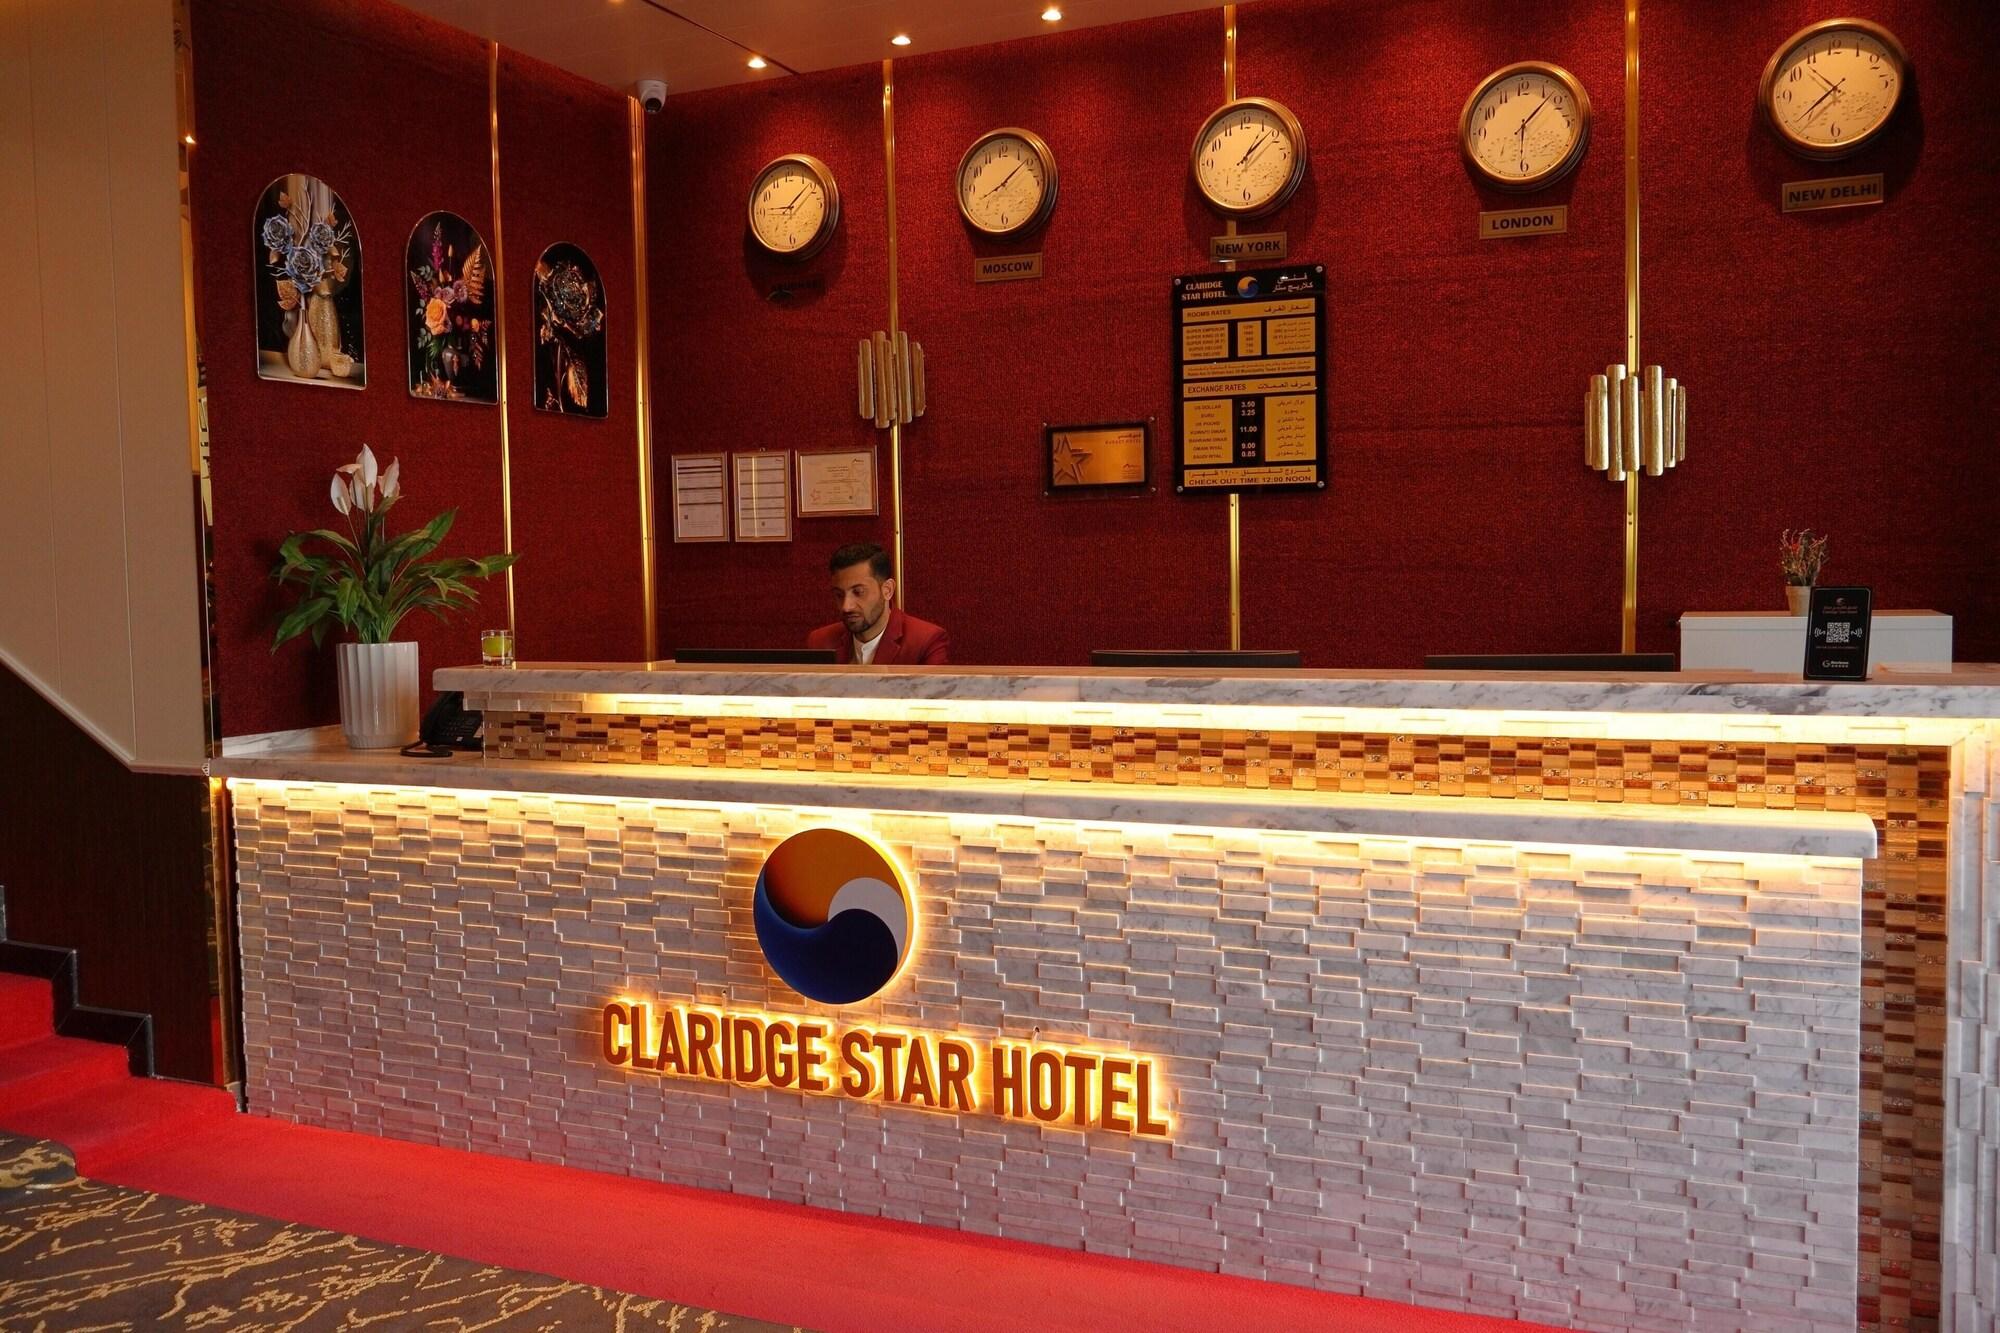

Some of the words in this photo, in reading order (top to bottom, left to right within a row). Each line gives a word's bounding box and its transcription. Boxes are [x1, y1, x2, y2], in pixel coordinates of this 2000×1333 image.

[1827, 39, 1843, 56] 12
[1806, 49, 1817, 65] 11
[1869, 53, 1882, 70] 2
[1790, 65, 1803, 83] 10
[1517, 80, 1530, 97] 12
[1782, 89, 1794, 103] 9
[1499, 89, 1508, 105] 11
[1553, 95, 1563, 111] 2
[1484, 105, 1496, 121] 10
[1224, 122, 1232, 137] 11
[1240, 116, 1251, 131] 12
[1830, 122, 1842, 137] 6
[1271, 130, 1280, 144] 2
[1478, 127, 1487, 140] 9
[1211, 138, 1222, 153] 10
[1206, 158, 1214, 169] 9
[1519, 159, 1529, 173] 6
[1242, 187, 1251, 201] 6
[1789, 188, 1826, 203] NEW
[1831, 184, 1878, 199] DELHI
[1492, 215, 1554, 230] LONDON
[1216, 243, 1244, 255] NEW
[1247, 240, 1281, 252] YORK
[983, 260, 1034, 274] MOSCOW
[1185, 281, 1224, 292] CLARIDGE
[1180, 292, 1201, 302] STAR
[1202, 290, 1228, 300] HOTEL
[1187, 384, 1225, 394] EXCHANGE
[1225, 383, 1247, 393] RATES
[1241, 409, 1256, 417] 3.25
[603, 1002, 834, 1092] CLARIDGE
[841, 1028, 975, 1112] STAR
[991, 1044, 1172, 1137] HOTEL
